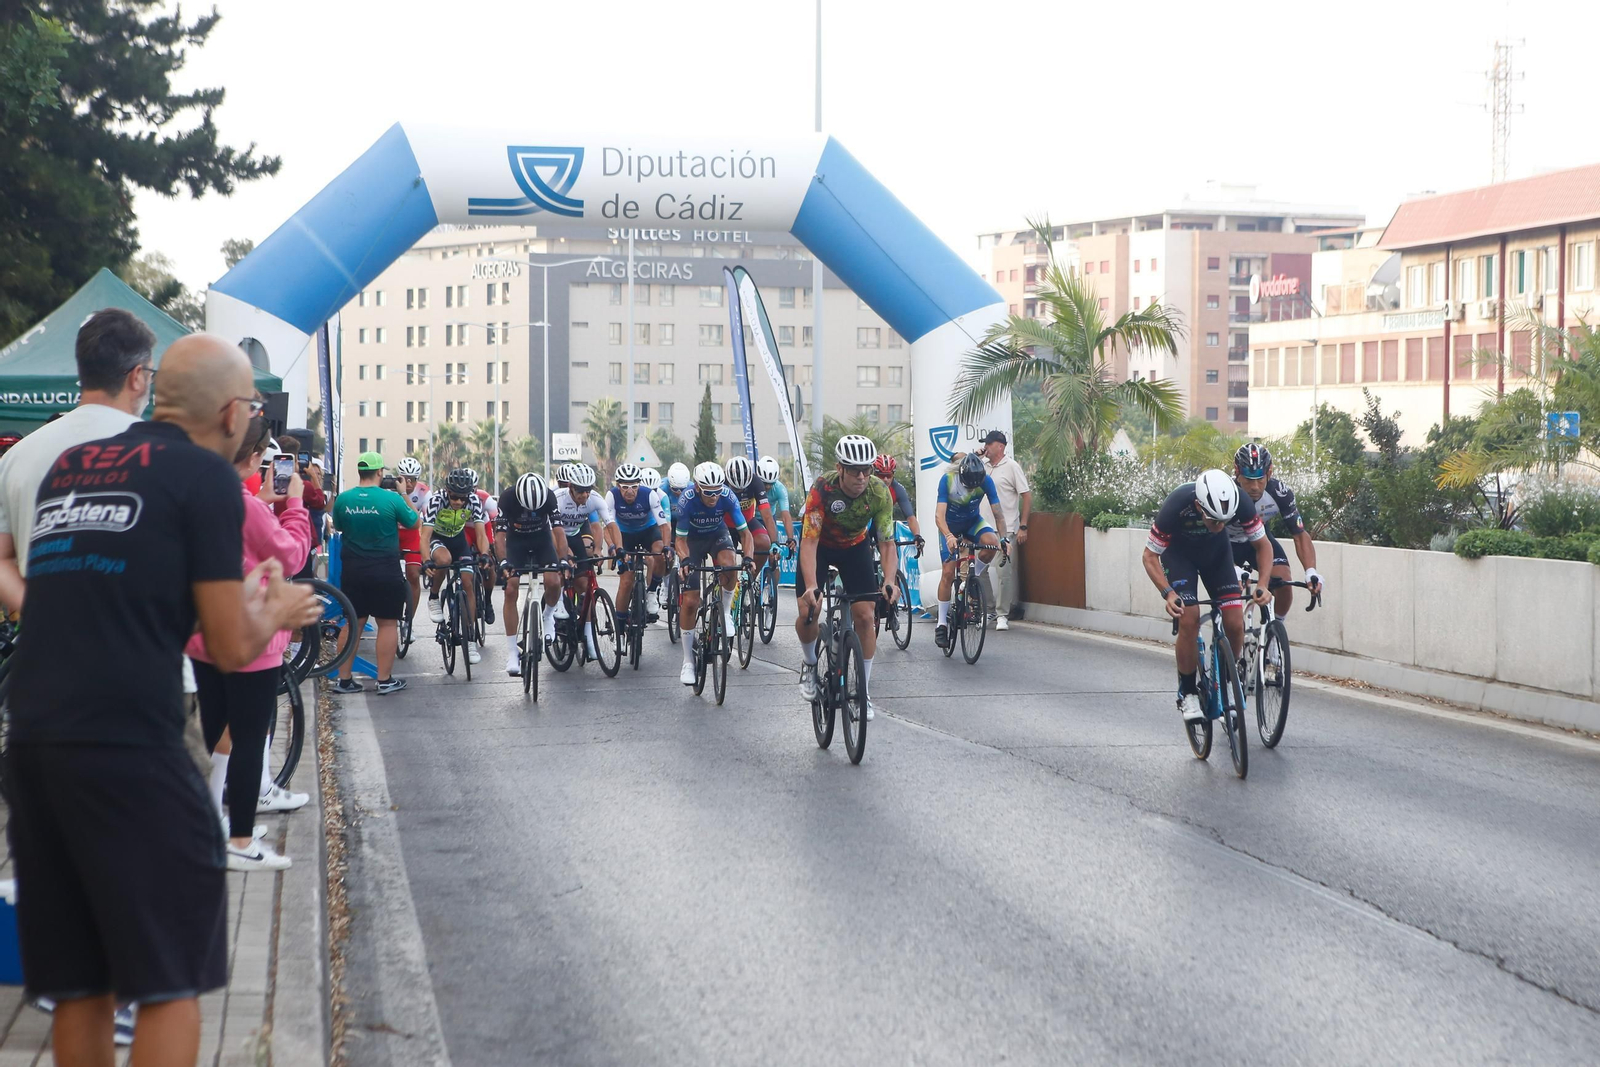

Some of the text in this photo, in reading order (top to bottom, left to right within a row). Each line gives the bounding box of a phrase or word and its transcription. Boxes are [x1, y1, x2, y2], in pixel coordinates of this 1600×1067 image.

[602, 147, 776, 183] Diputación
[601, 193, 744, 220] de Cádiz
[693, 230, 753, 243] HOTEL
[471, 261, 520, 280] ALGECRAS
[586, 261, 693, 279] ALGECIRAS
[1260, 273, 1298, 297] vodafone
[558, 447, 578, 455] GYM
